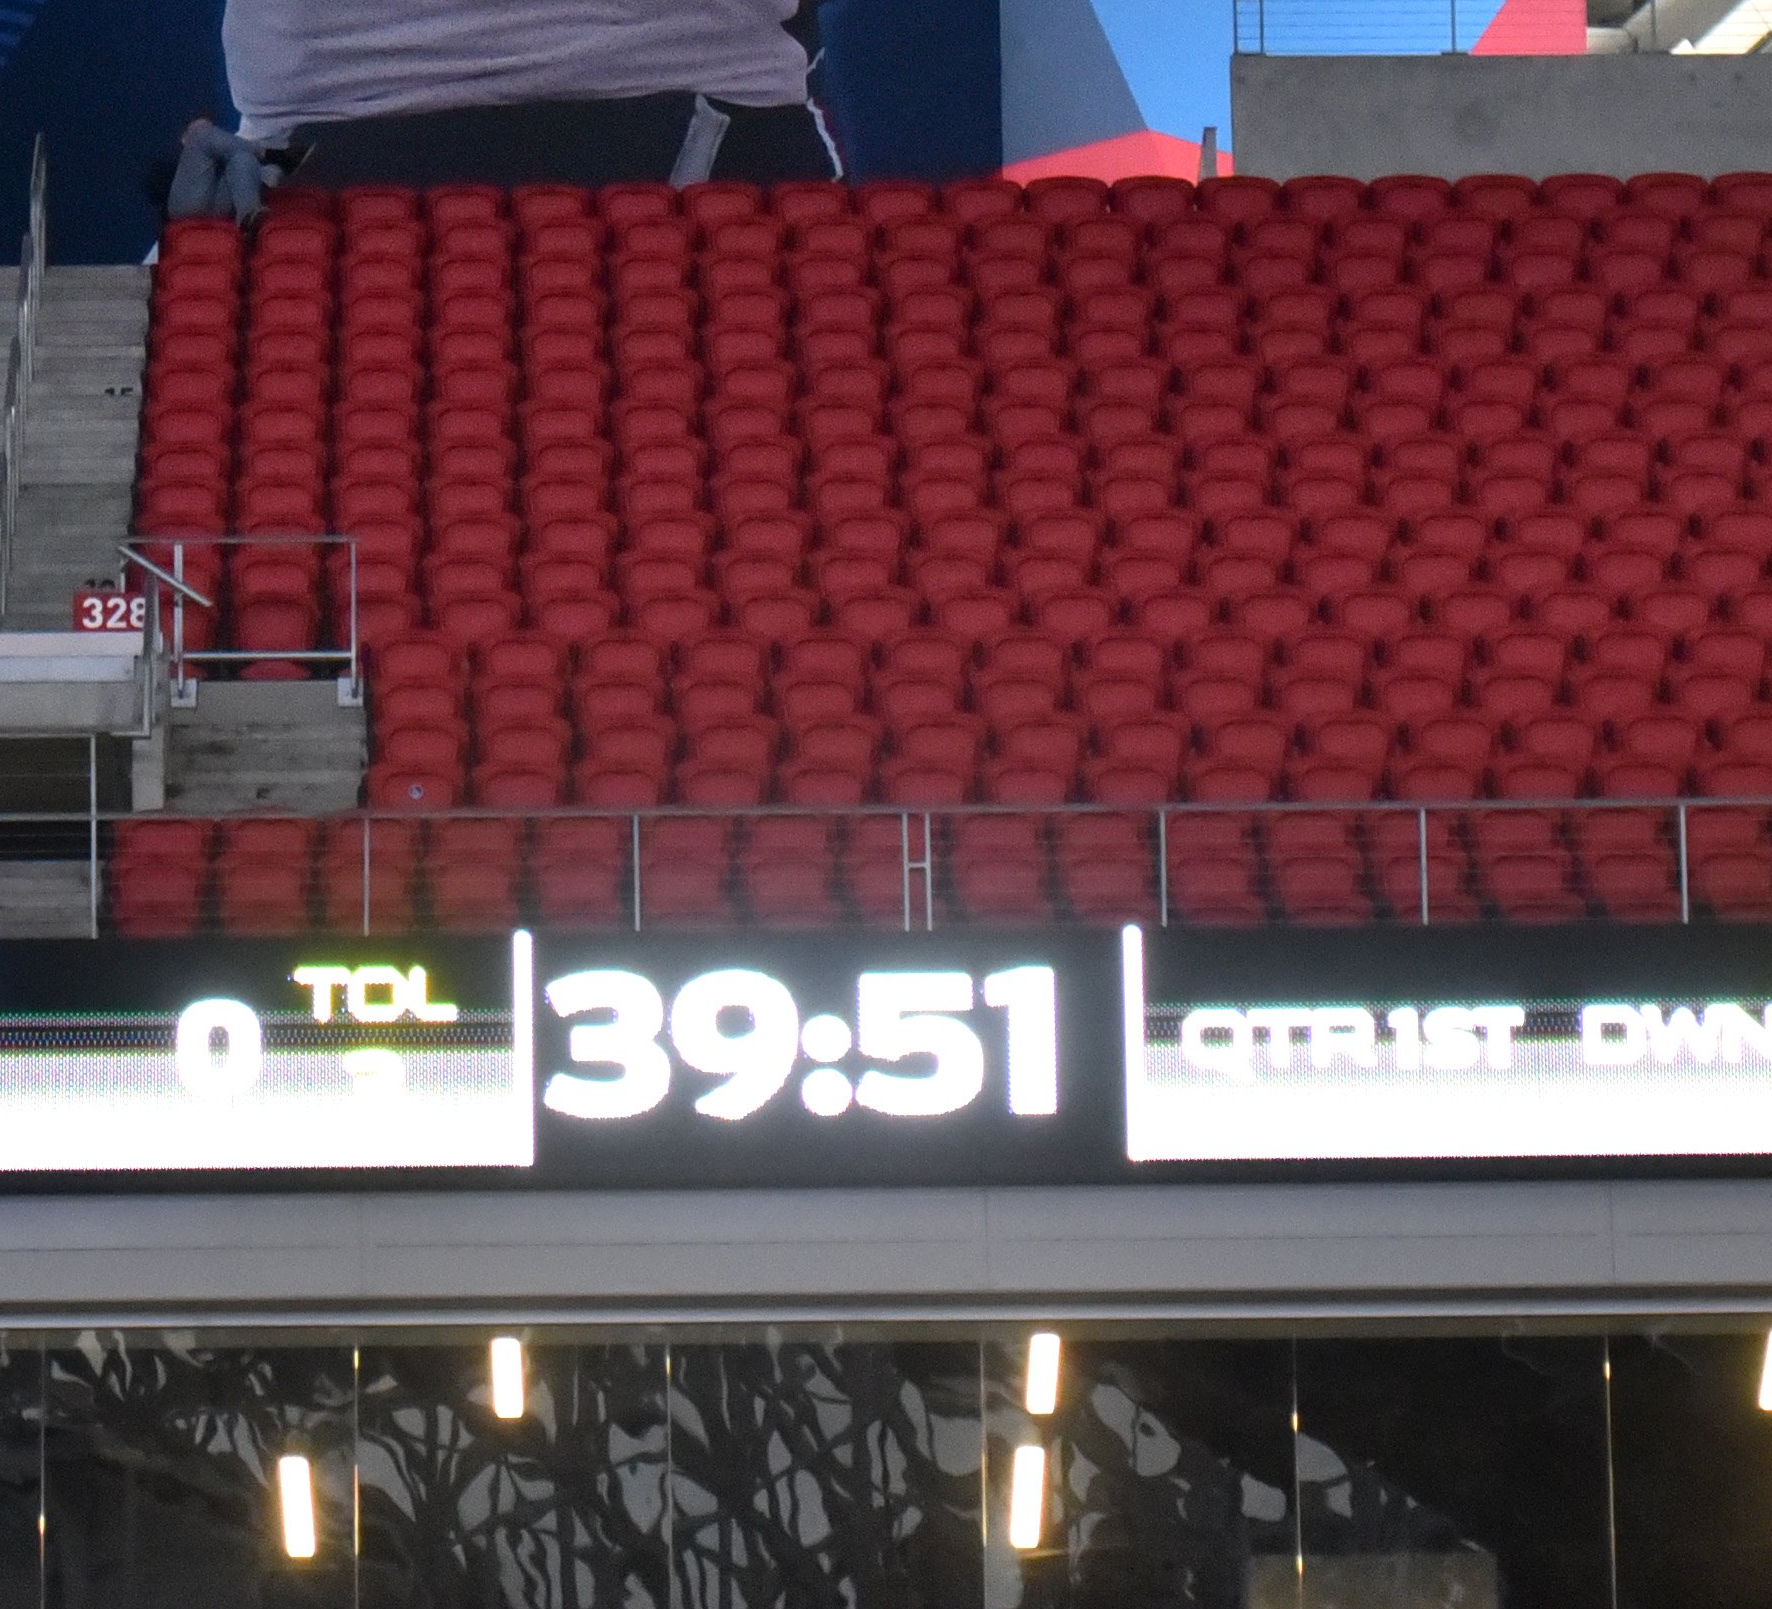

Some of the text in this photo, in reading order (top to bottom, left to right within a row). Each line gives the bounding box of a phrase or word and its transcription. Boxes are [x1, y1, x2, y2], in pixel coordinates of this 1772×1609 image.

[294, 965, 457, 1023] TOL
[175, 997, 262, 1101] 0
[543, 965, 1057, 1120] 39:51
[1182, 1004, 1526, 1084] QTR 1ST
